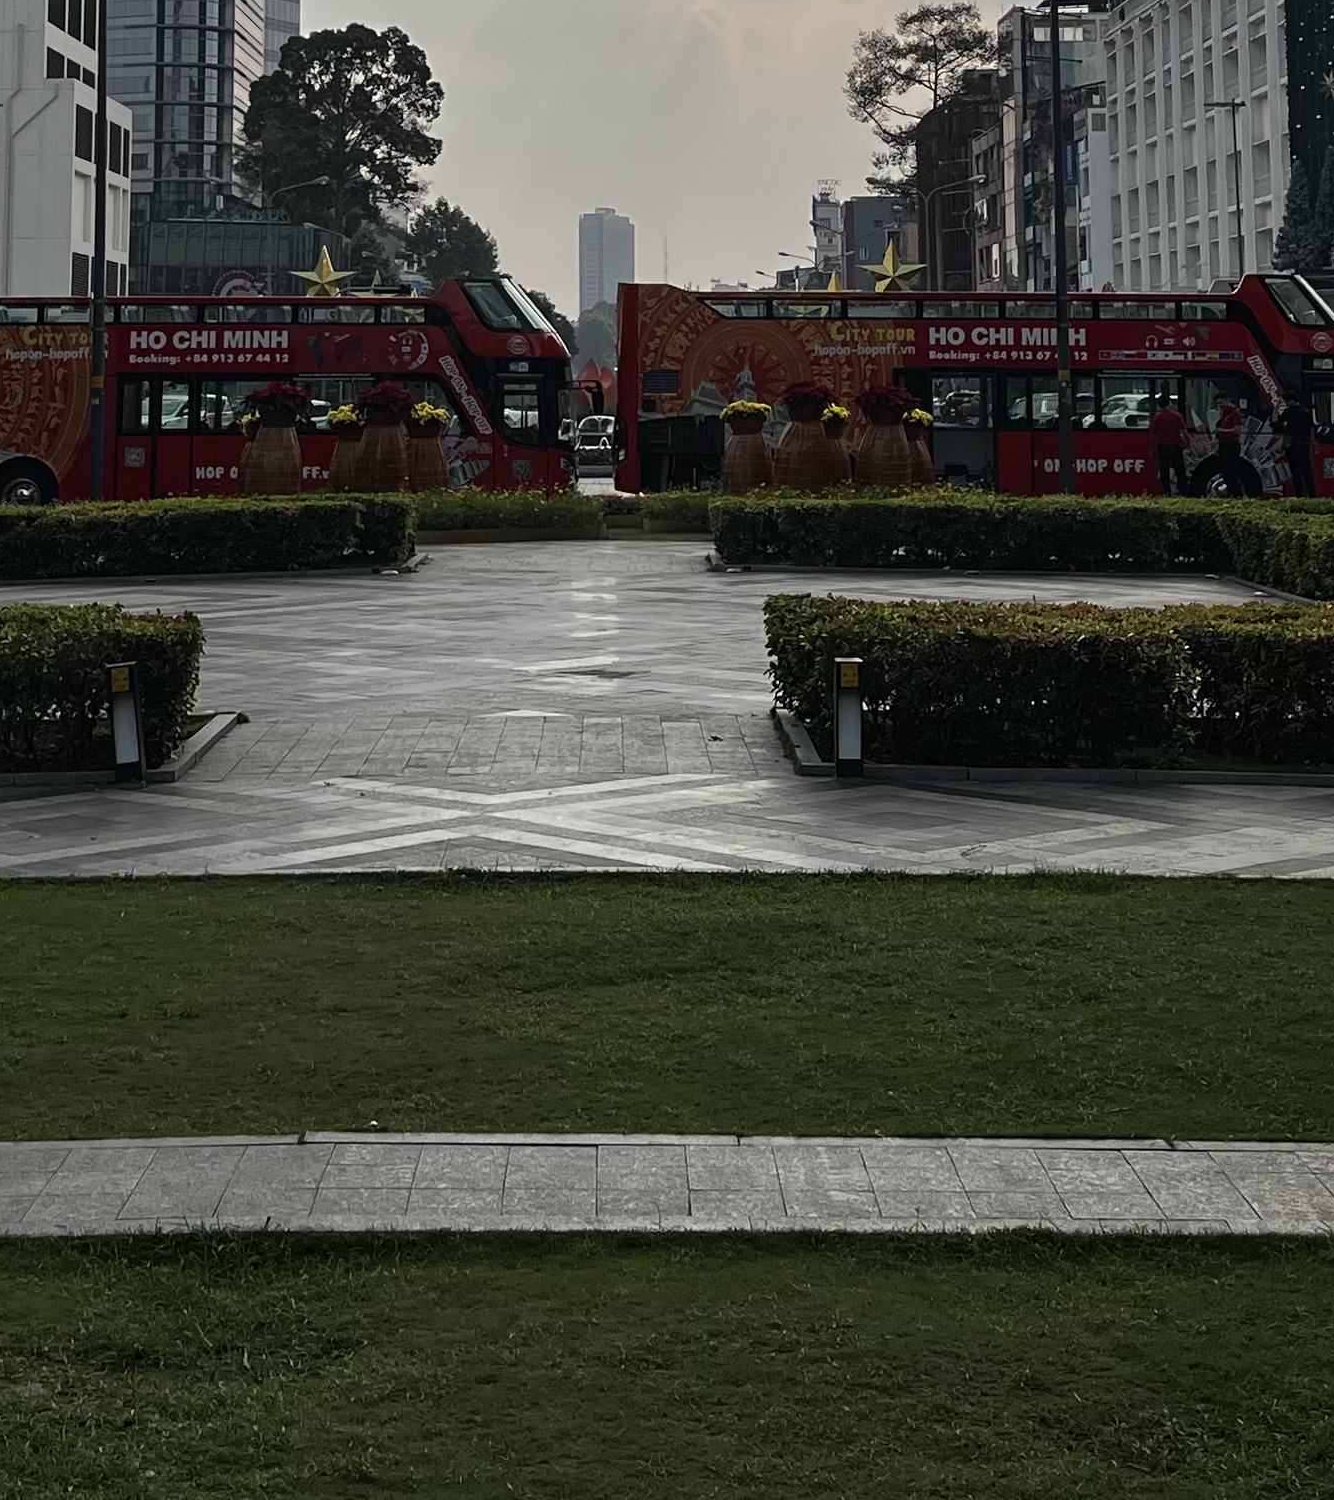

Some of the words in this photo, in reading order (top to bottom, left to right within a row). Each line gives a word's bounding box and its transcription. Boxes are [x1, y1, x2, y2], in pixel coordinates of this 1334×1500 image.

[129, 330, 167, 350] HO
[172, 330, 217, 350] CHI
[223, 330, 289, 350] MINH
[929, 327, 965, 346] HO
[971, 327, 1015, 346] CHI
[814, 342, 916, 358] hopon-hopoff.vn
[984, 350, 1008, 360] +84
[1011, 350, 1033, 360] 913
[1036, 350, 1052, 360] 67
[1073, 351, 1088, 361] 12
[185, 354, 208, 364] +84
[212, 353, 235, 363] 913
[237, 353, 253, 363] 67
[255, 353, 271, 363] 44
[275, 353, 290, 363] 12
[1248, 356, 1267, 376] HOP
[440, 356, 459, 376] HOP
[475, 417, 492, 434] OFF
[195, 466, 225, 480] HOP
[1113, 458, 1146, 473] OFF
